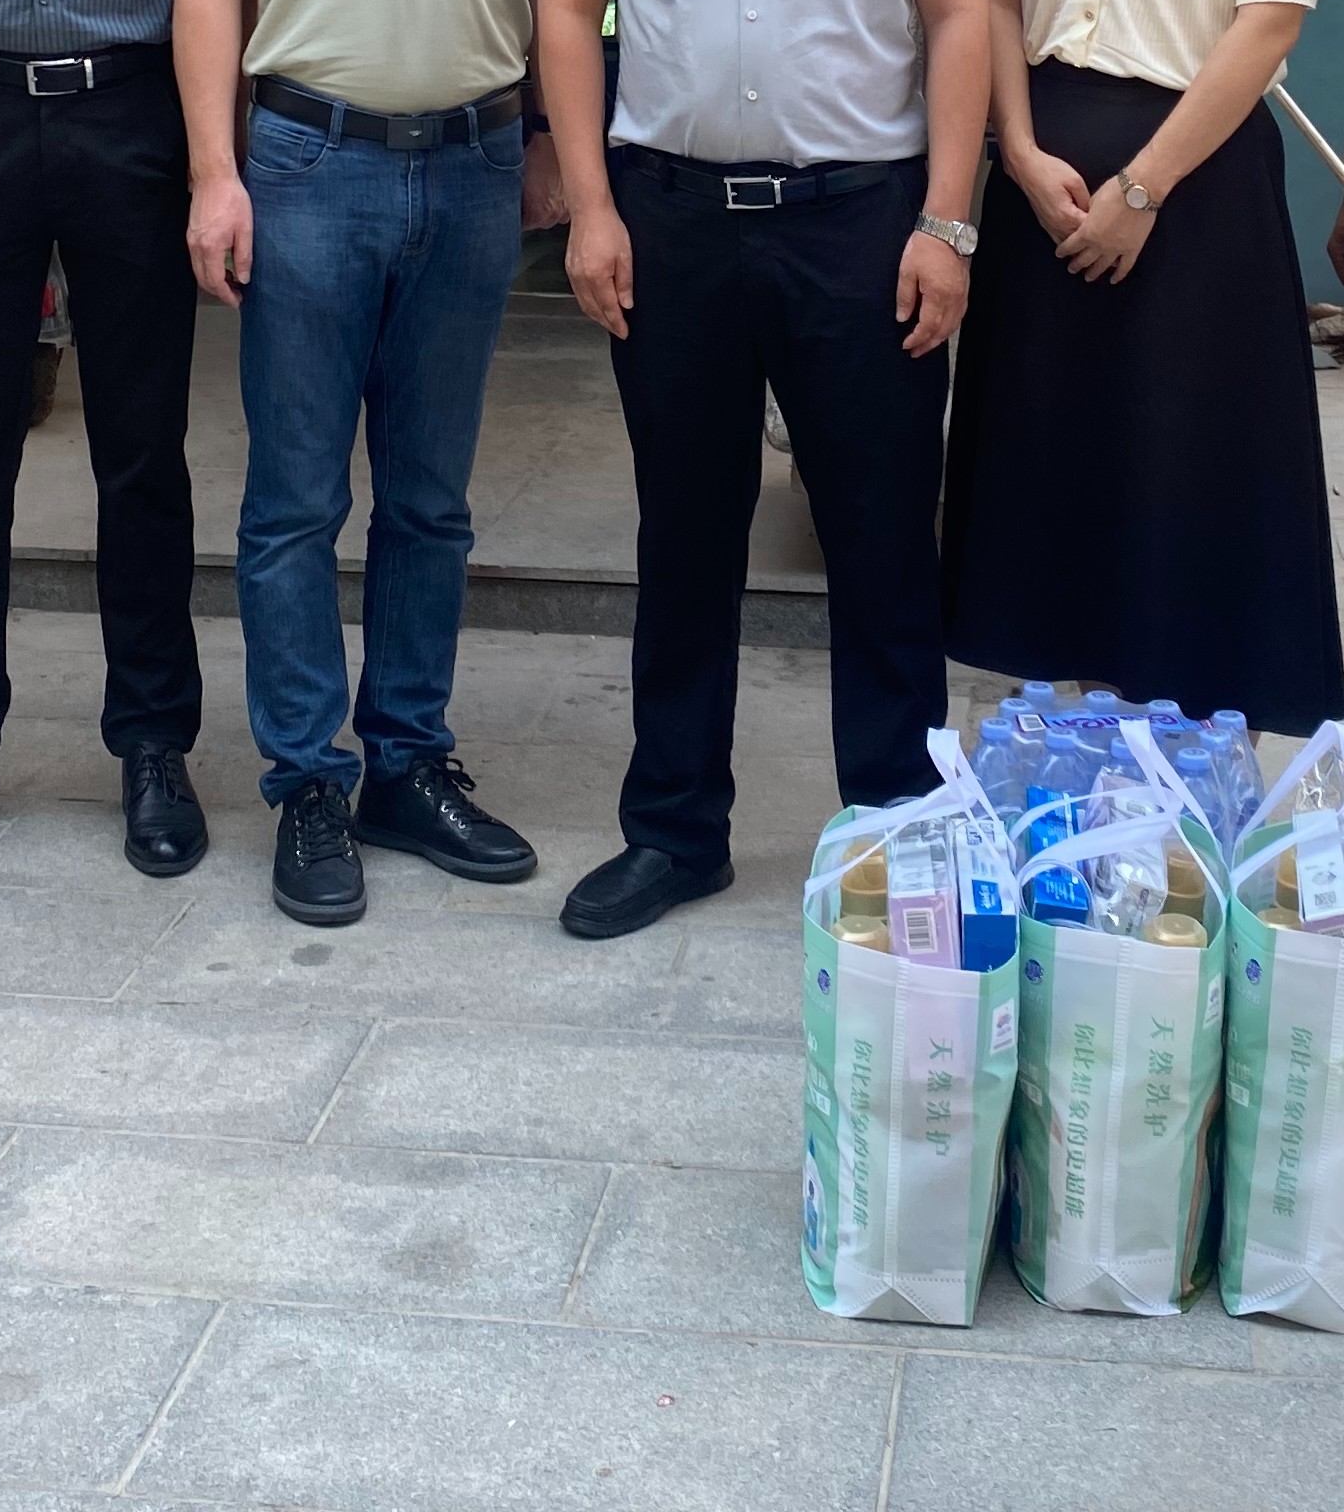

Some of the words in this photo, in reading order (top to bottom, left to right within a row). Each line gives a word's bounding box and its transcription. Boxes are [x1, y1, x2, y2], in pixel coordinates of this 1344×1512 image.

[850, 1037, 874, 1232] 你比想象的更超能
[925, 1035, 955, 1158] 天然洗护
[1064, 1022, 1096, 1220] 你比想象的更超能
[1143, 1015, 1176, 1138] 天然洗护
[1271, 1024, 1314, 1219] 你比想象的更超能
